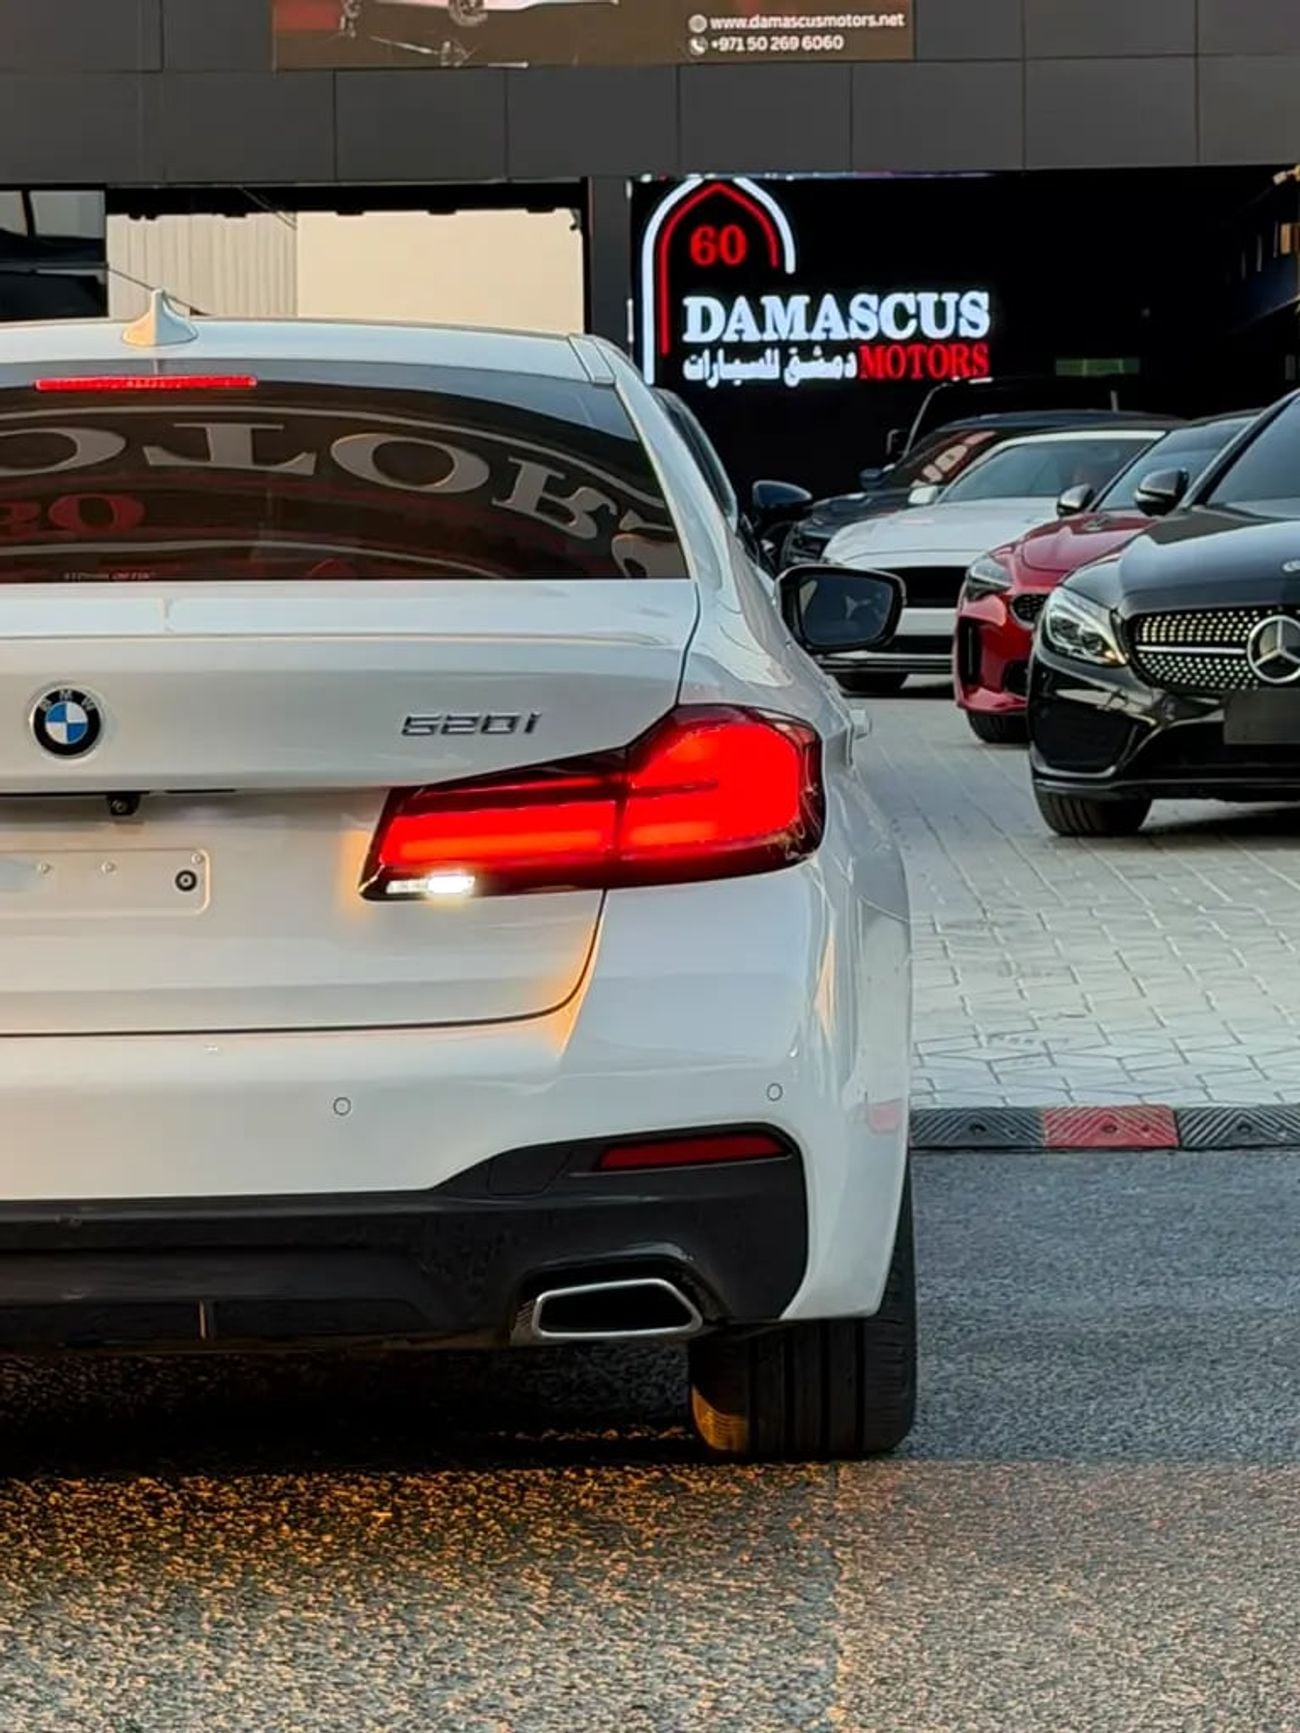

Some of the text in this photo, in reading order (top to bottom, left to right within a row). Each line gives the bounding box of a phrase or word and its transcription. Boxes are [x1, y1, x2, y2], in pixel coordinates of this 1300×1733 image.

[710, 14, 905, 30] www.damascusmotors.net
[711, 35, 844, 51] +971 50 269 6060
[690, 225, 747, 266] 60
[682, 291, 991, 343] DAMASCUS
[783, 345, 858, 388] دمشق
[859, 344, 990, 381] MOTORS
